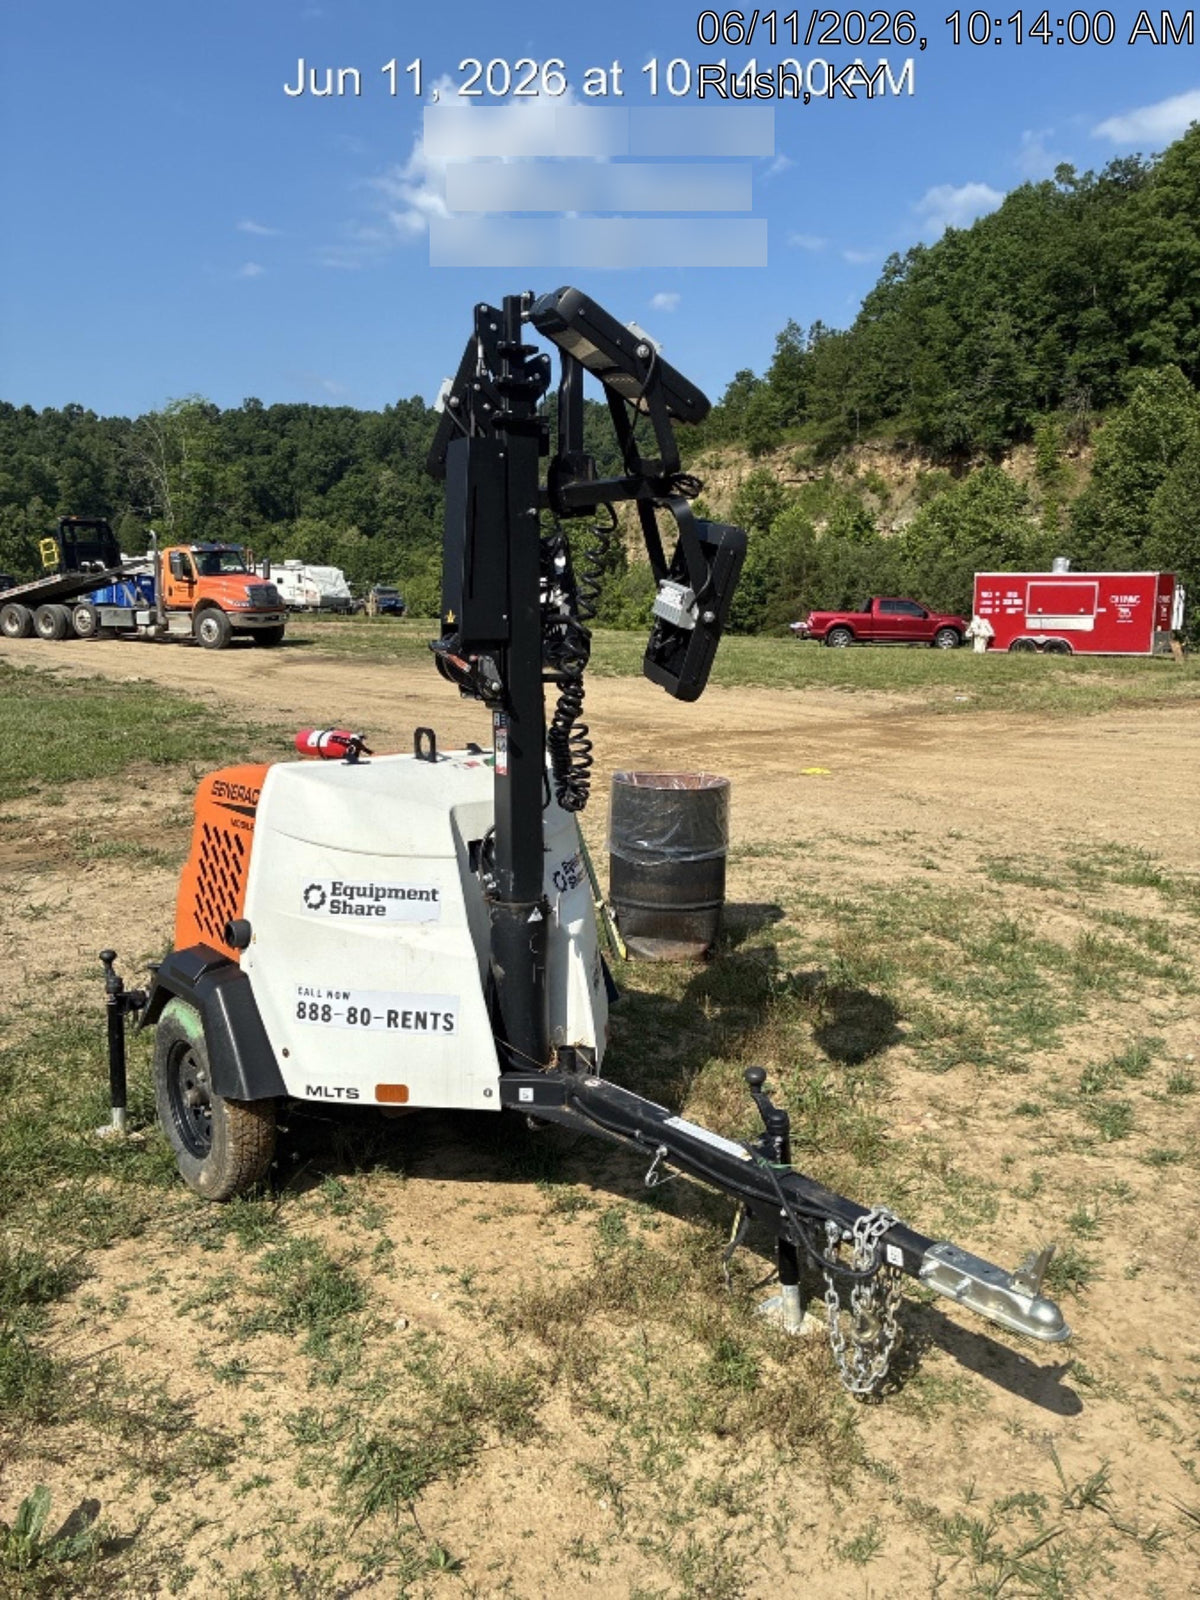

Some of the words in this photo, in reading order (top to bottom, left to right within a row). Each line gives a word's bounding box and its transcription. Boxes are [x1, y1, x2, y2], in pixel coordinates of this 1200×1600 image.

[330, 881, 439, 902] Equipment
[329, 899, 386, 916] Share
[297, 986, 323, 998] CALL
[326, 990, 351, 1000] NOW
[296, 1001, 455, 1032] 888-80-RENTS
[305, 1084, 360, 1100] MLTS
